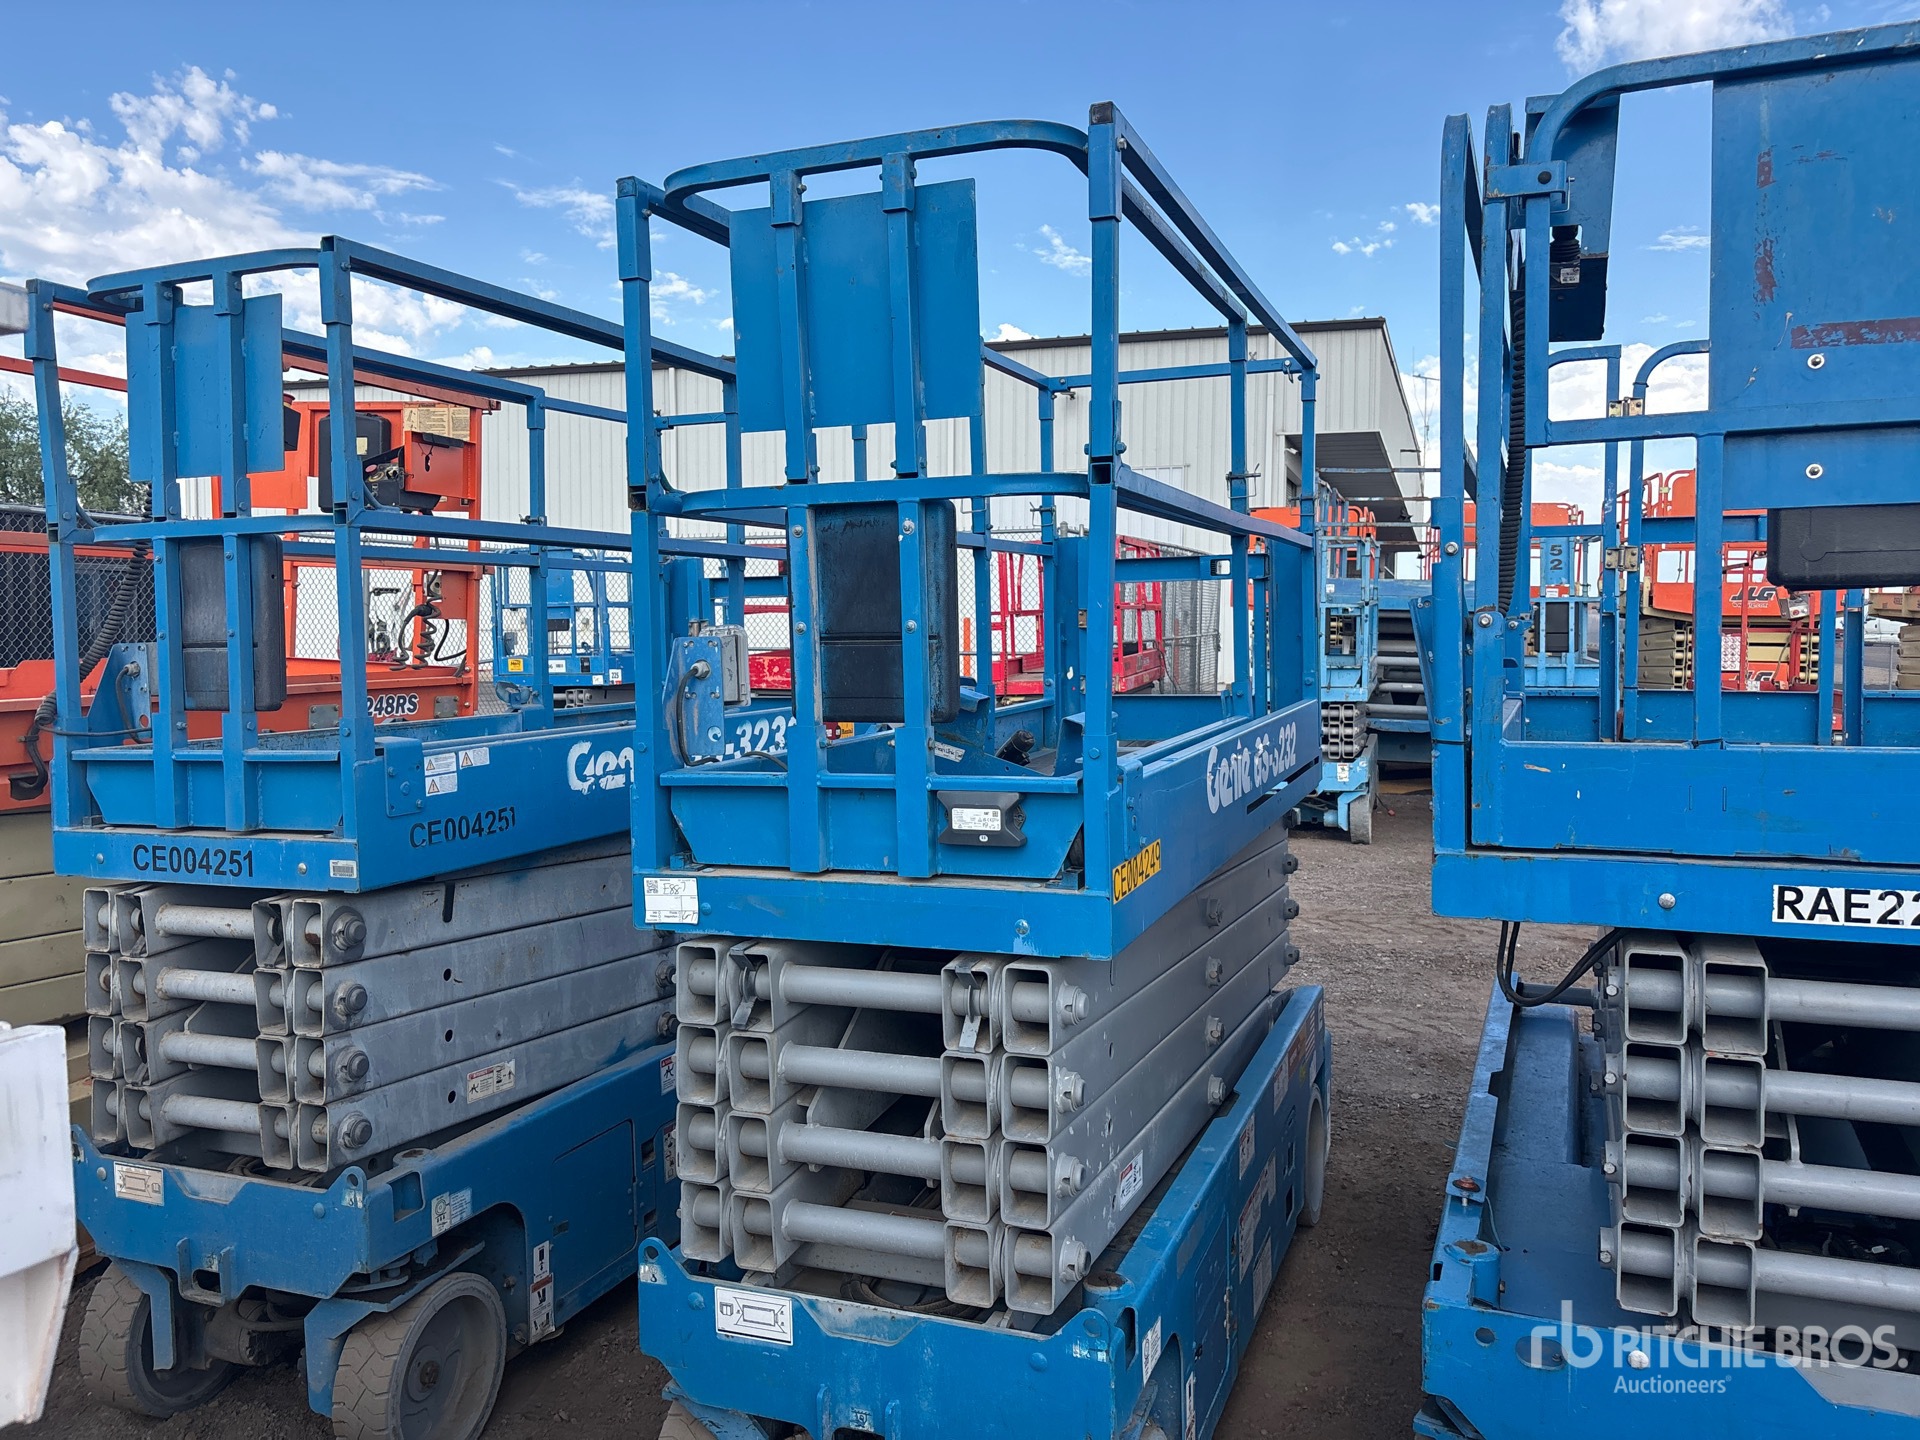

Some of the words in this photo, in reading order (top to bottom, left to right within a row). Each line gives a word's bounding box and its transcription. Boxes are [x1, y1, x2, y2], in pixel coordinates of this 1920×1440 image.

[366, 693, 420, 718] 248RS
[567, 740, 635, 795] Gen
[1206, 737, 1251, 814] Genie
[409, 806, 516, 849] CE004251
[133, 844, 254, 878] CE004251
[1113, 841, 1161, 902] CE004249
